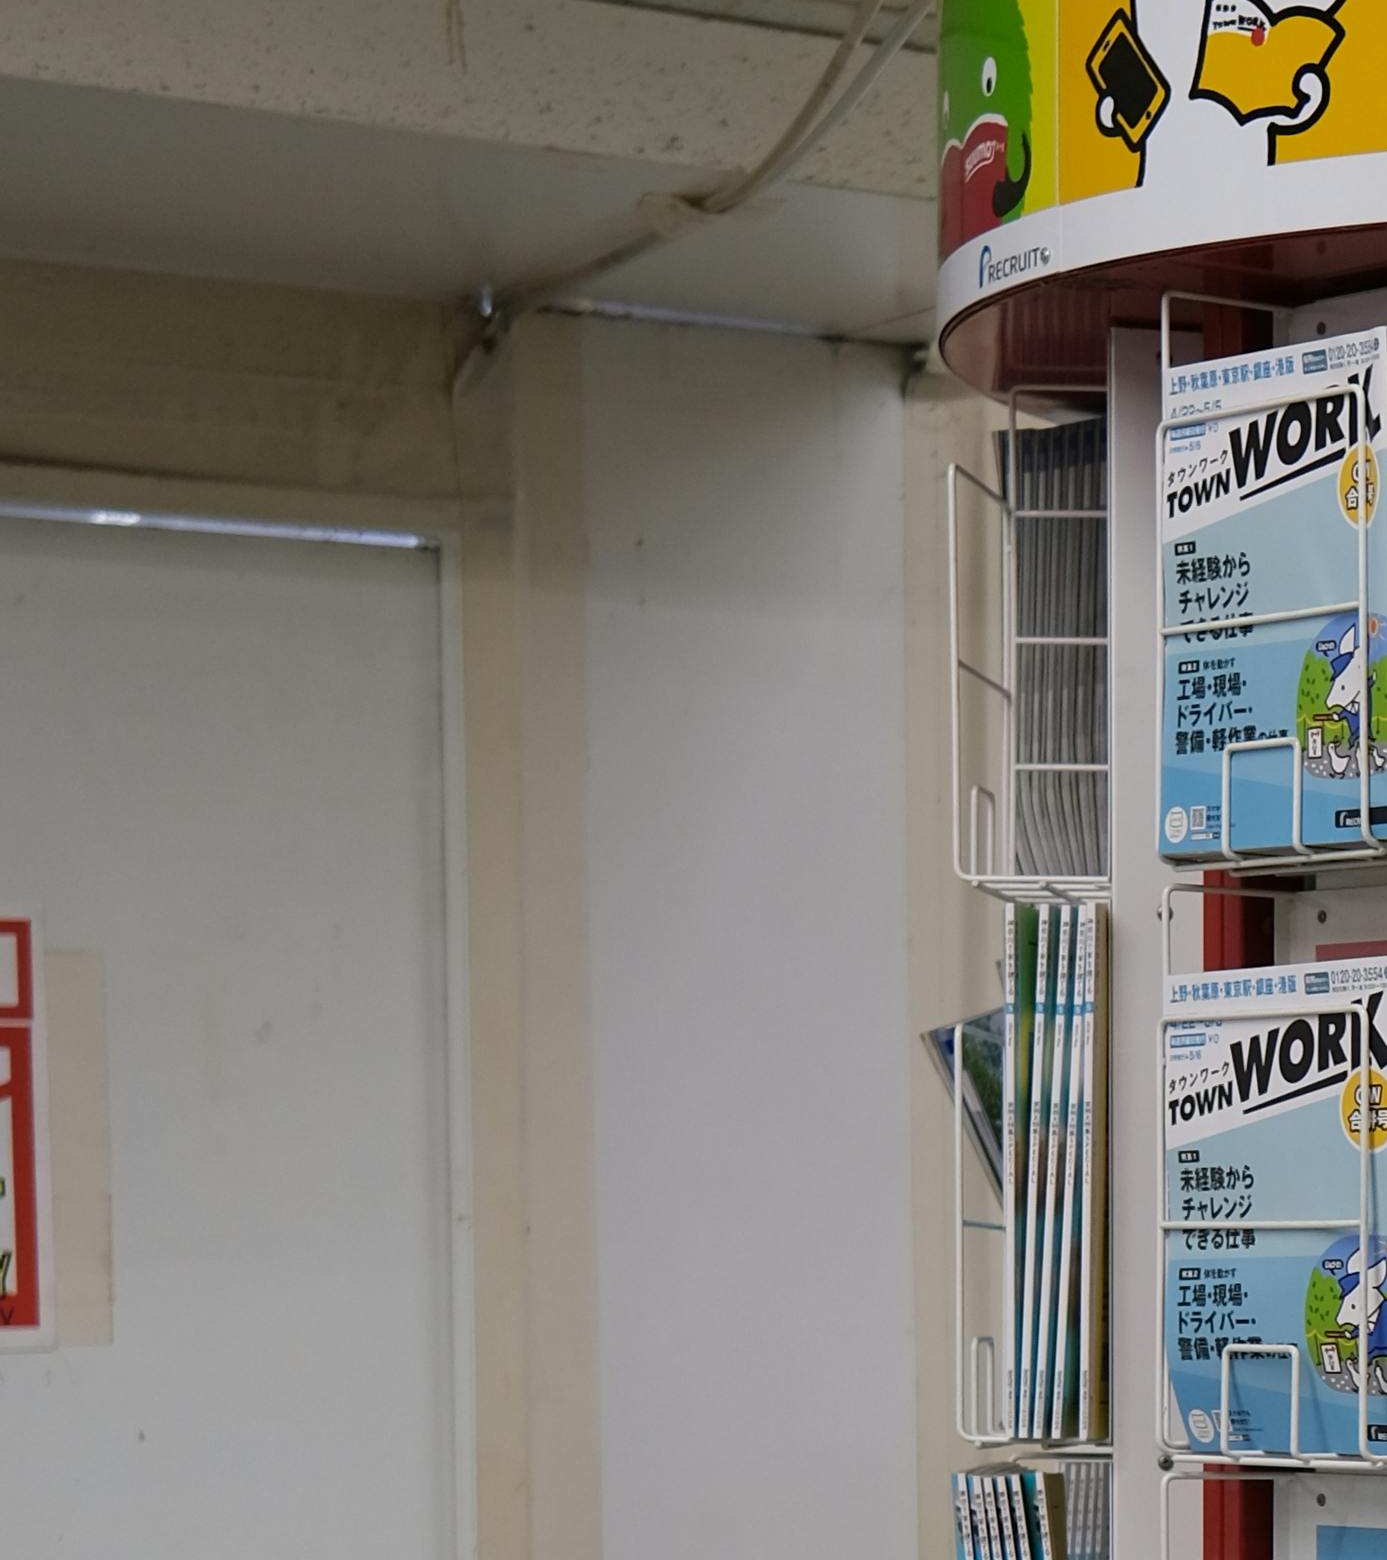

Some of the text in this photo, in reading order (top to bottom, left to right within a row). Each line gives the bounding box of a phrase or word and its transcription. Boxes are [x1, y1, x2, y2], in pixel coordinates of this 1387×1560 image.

[989, 247, 1040, 283] RECRUIT
[1166, 468, 1231, 518] TOWN
[1175, 552, 1250, 585] 未経験から
[1179, 582, 1249, 614] チャレンジ
[1330, 966, 1384, 985] 0120-20-3554
[1169, 1061, 1231, 1094] タウンワーク
[1168, 1080, 1232, 1125] TOWN
[1180, 1164, 1254, 1192] 未経験から
[1181, 1195, 1252, 1221] チャレンジ
